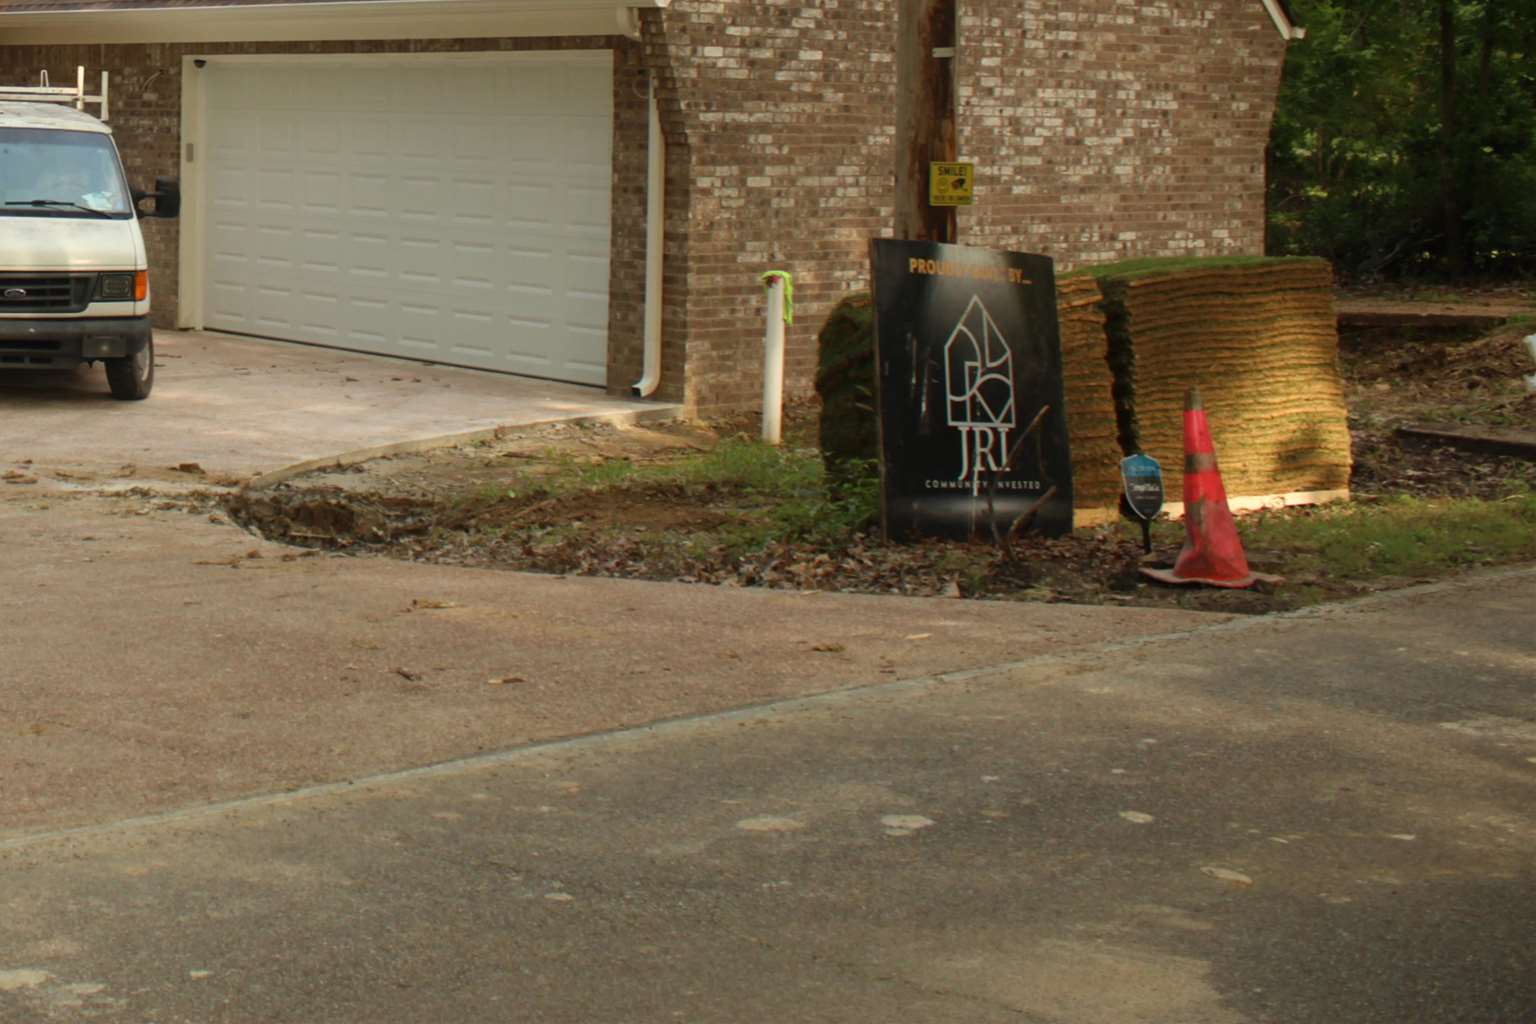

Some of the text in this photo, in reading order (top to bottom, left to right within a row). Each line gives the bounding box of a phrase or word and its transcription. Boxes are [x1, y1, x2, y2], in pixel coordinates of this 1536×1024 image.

[909, 258, 970, 278] PROUD
[958, 426, 1011, 481] JRI
[924, 479, 1041, 490] COMMUNTY NVESTED
